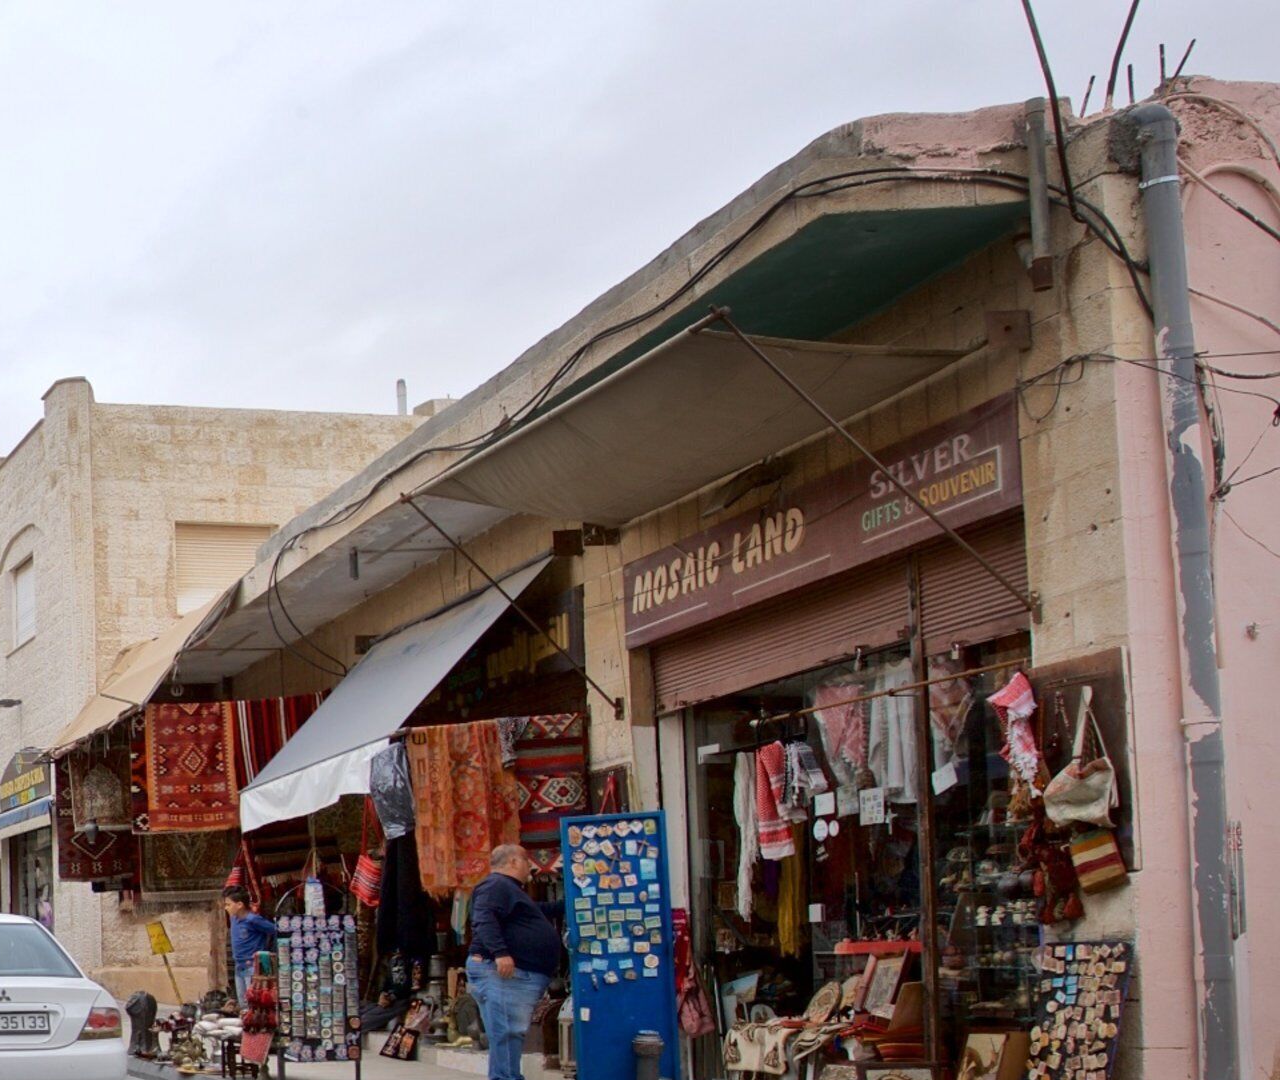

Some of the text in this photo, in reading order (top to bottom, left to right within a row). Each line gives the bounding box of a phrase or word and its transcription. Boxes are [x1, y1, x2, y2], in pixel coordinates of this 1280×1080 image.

[861, 499, 901, 532] GIFTS
[918, 459, 996, 508] SOUVENIR
[870, 433, 972, 499] SILVER
[631, 506, 805, 615] MOSAIC LAND
